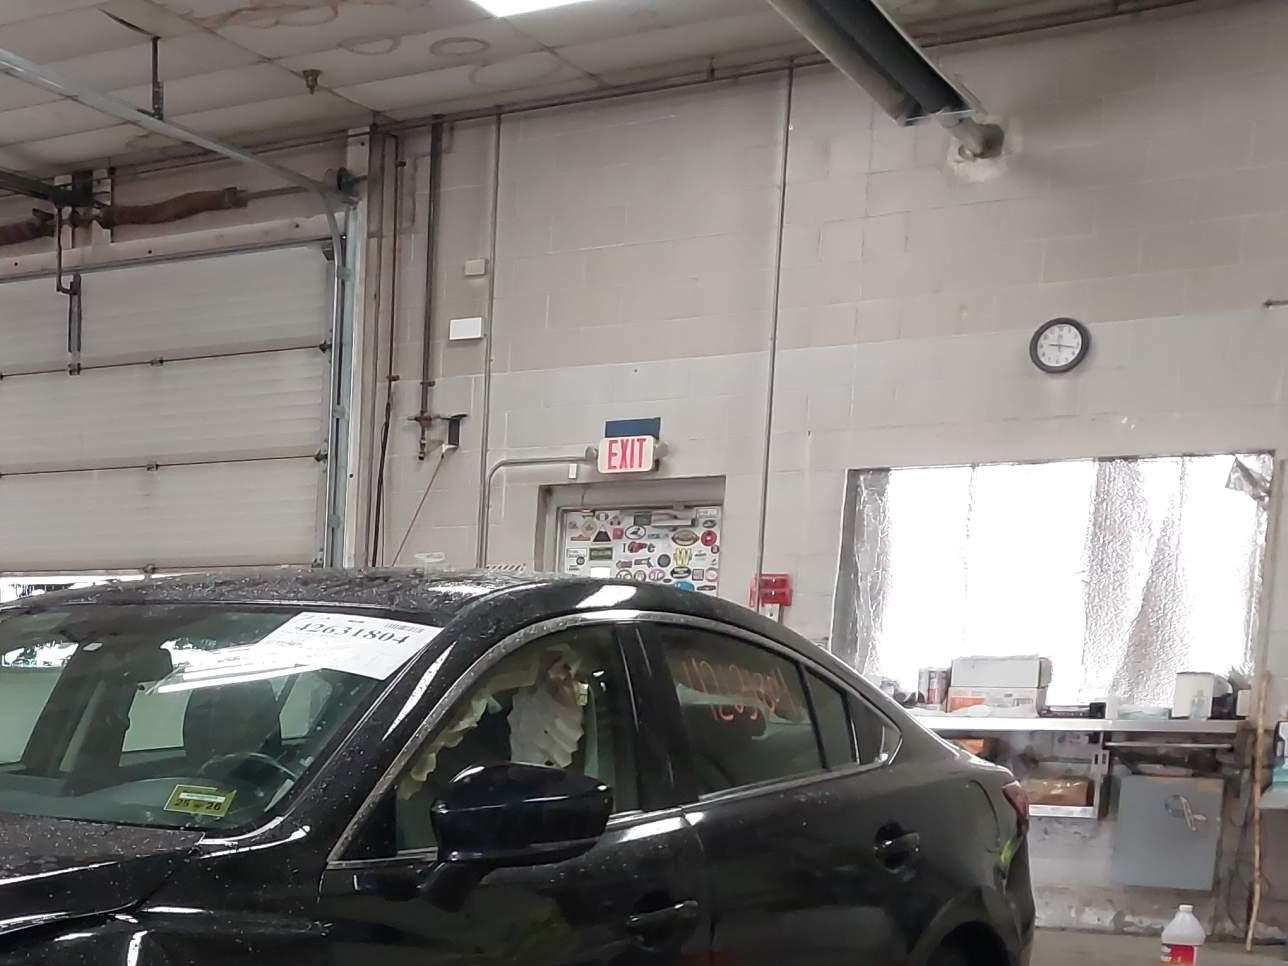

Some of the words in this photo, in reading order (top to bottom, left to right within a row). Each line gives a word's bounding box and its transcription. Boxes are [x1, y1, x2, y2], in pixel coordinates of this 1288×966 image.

[607, 439, 646, 470] EXIT
[296, 622, 410, 644] 42631804
[206, 801, 222, 811] 26
